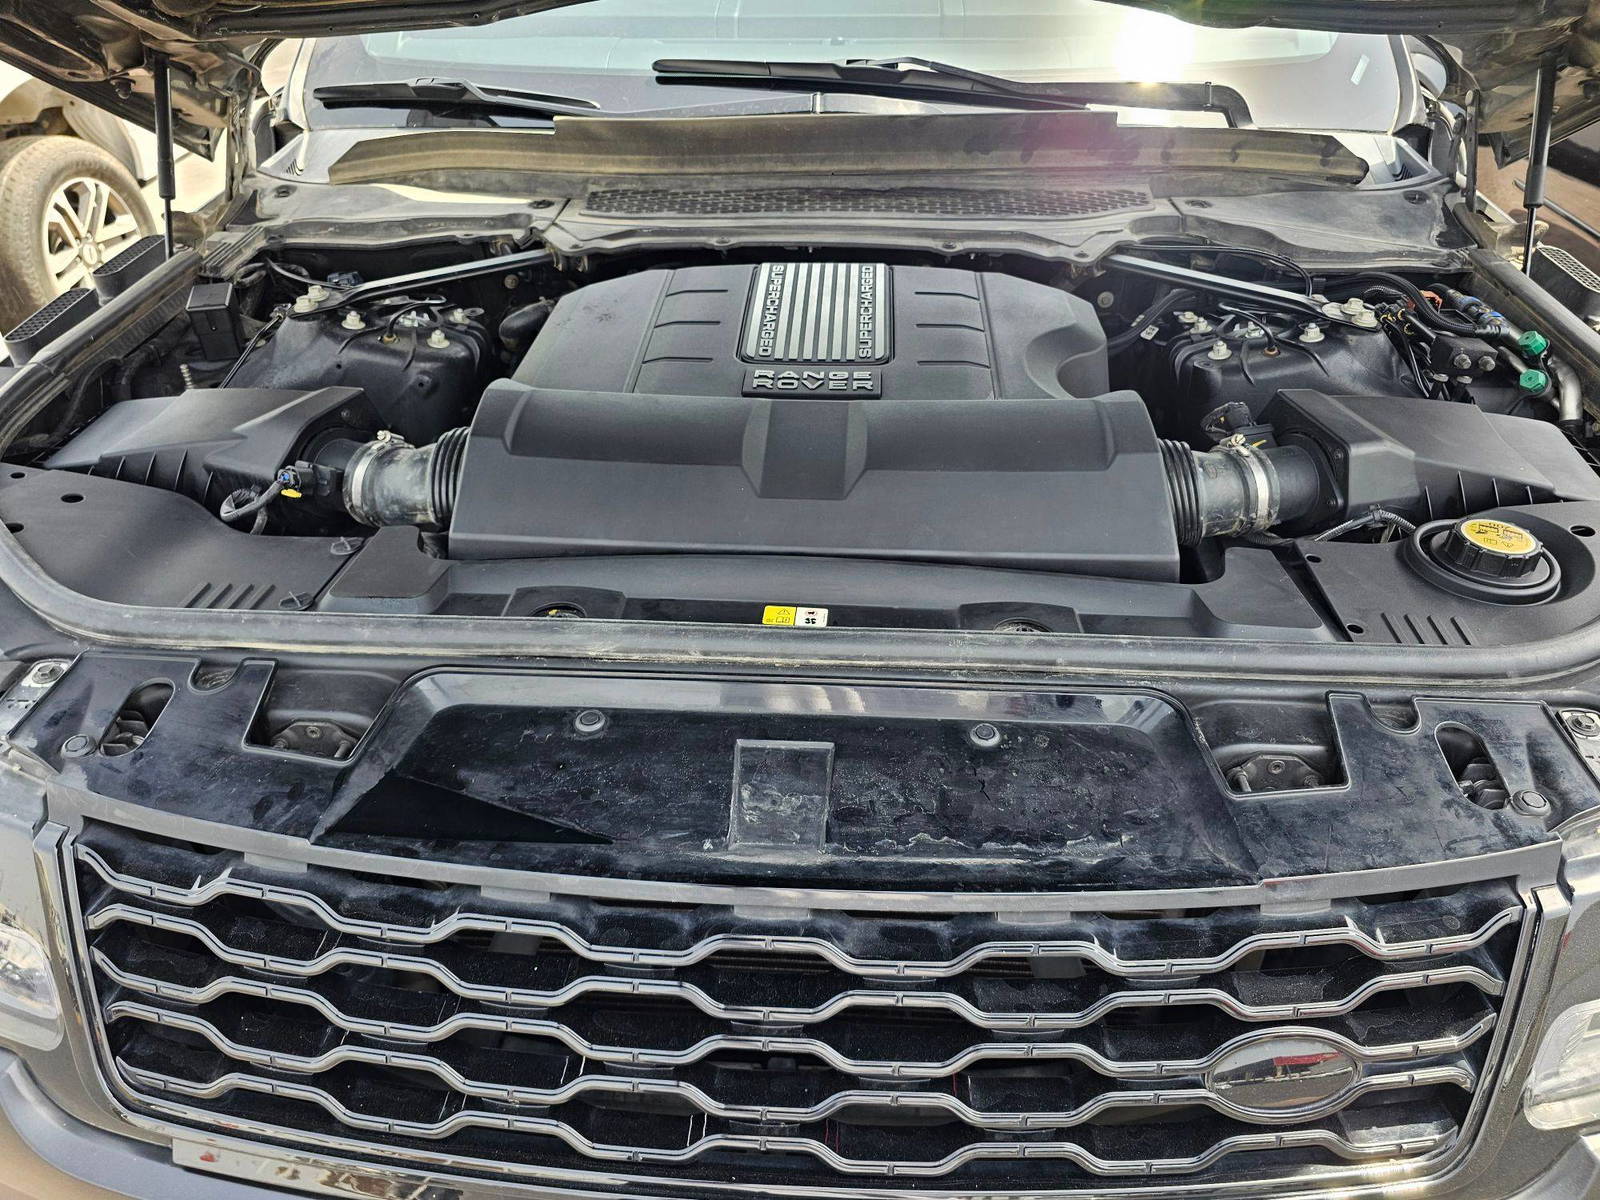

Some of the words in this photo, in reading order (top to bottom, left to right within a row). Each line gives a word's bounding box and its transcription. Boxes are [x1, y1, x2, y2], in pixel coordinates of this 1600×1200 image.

[758, 265, 784, 357] SUPERCHARGED
[859, 265, 873, 359] SUPERCHARGED
[752, 378, 873, 391] ROVER
[754, 369, 872, 380] RANGE
